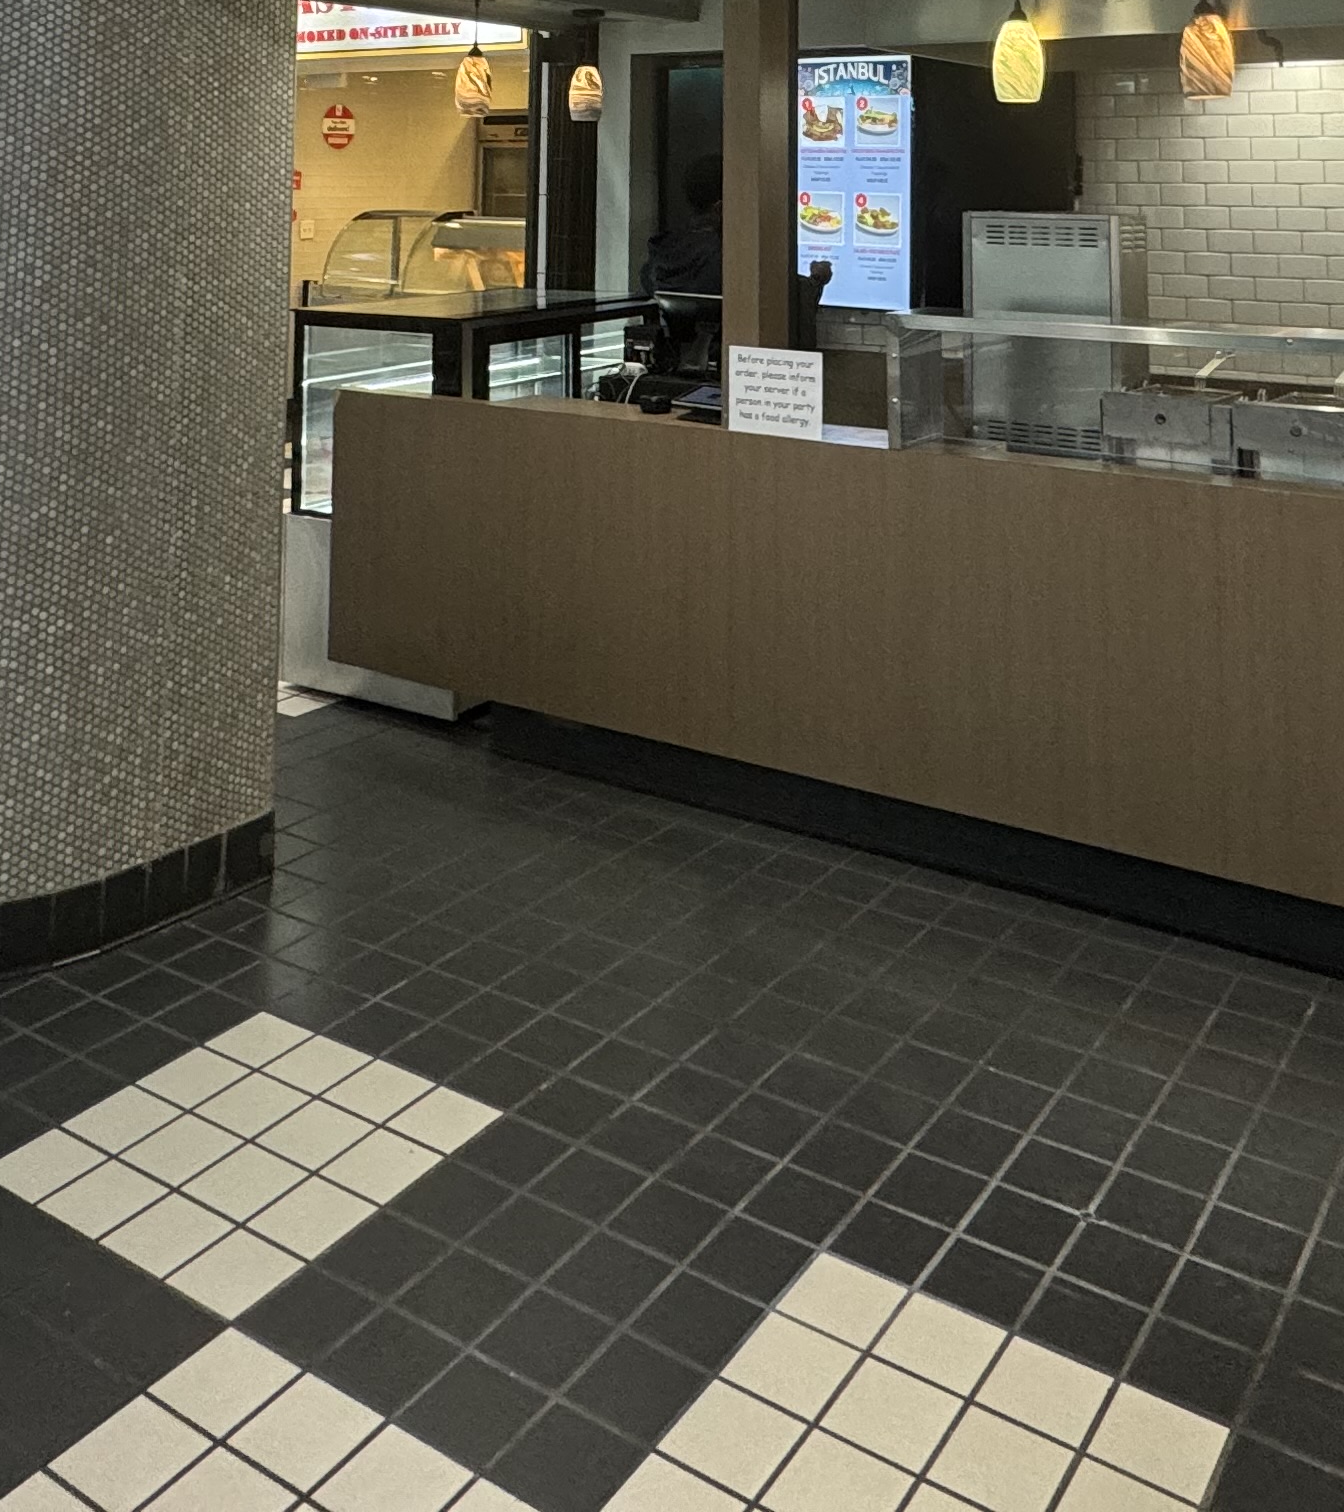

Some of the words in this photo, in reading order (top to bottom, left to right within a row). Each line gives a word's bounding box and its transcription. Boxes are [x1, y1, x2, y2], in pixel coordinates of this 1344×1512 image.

[349, 25, 408, 40] ON-SITE
[412, 22, 461, 37] DAILY
[814, 62, 889, 86] ISTANBUL
[737, 354, 764, 364] Before
[766, 357, 794, 369] placing
[796, 361, 814, 369] your
[761, 371, 787, 380] please
[789, 373, 816, 383] inform
[744, 385, 762, 394] your
[764, 386, 790, 395] server
[792, 387, 799, 396] if
[735, 398, 762, 406] person
[773, 401, 791, 409] your
[793, 403, 815, 413] party
[739, 409, 752, 419] has
[761, 412, 780, 422] food
[782, 413, 811, 427] allergy.
